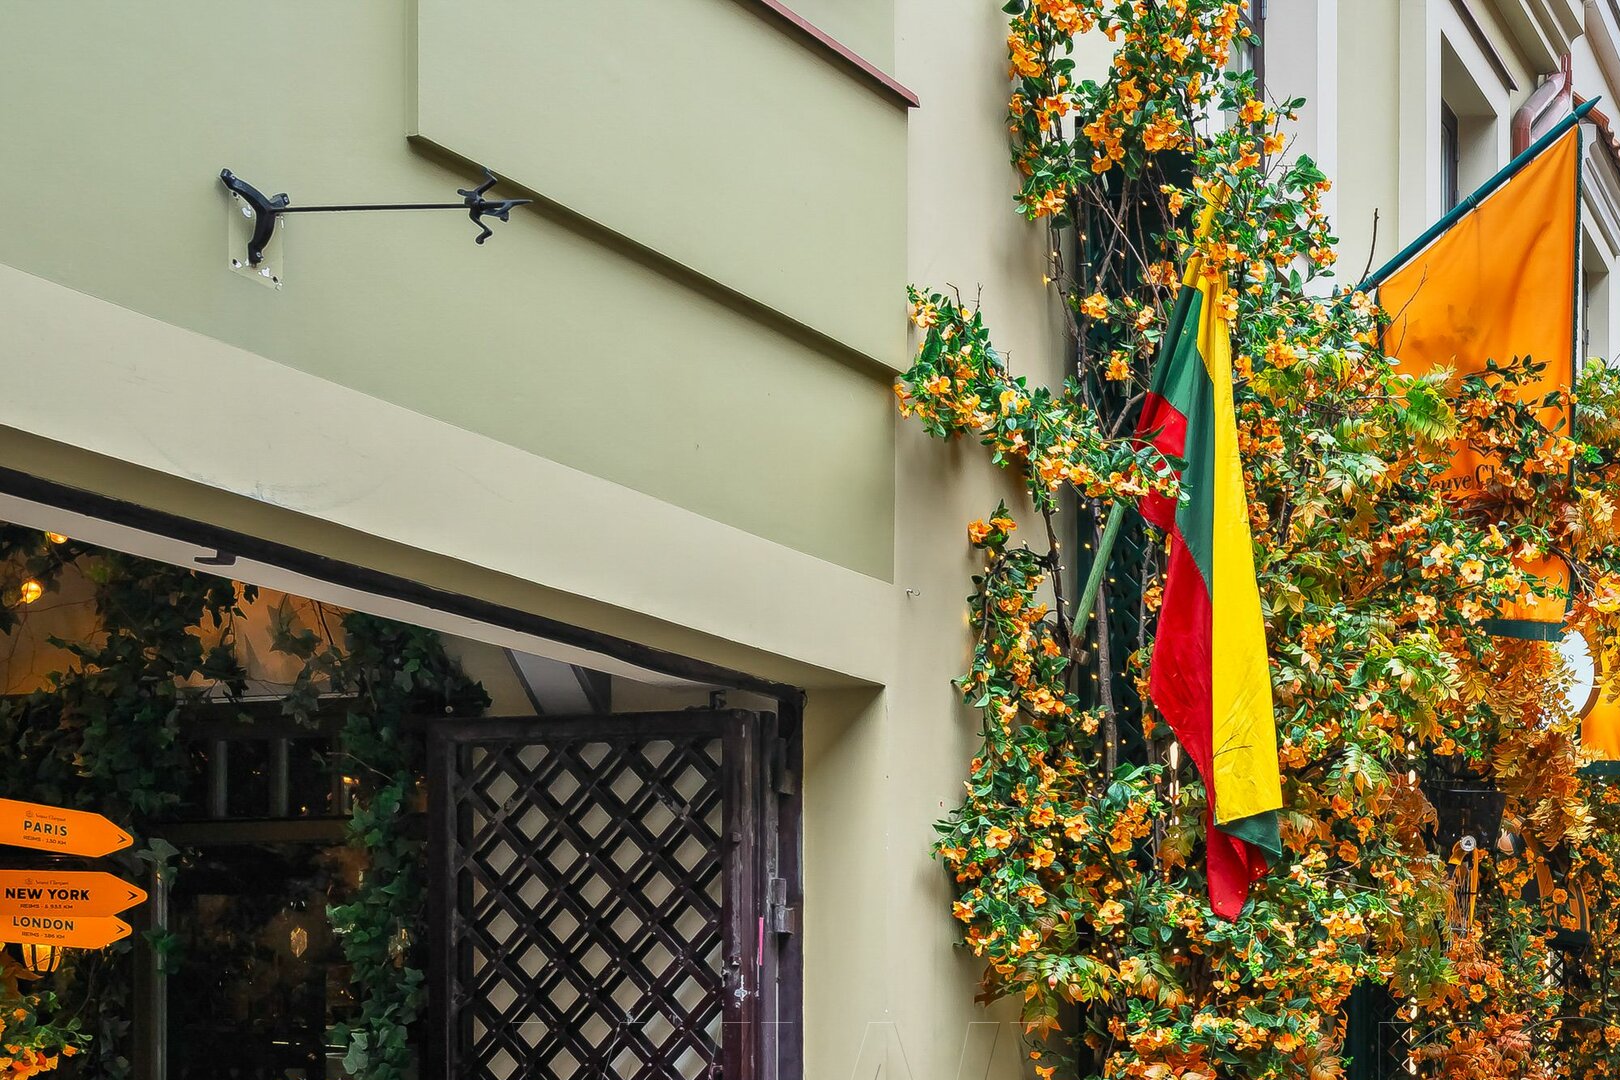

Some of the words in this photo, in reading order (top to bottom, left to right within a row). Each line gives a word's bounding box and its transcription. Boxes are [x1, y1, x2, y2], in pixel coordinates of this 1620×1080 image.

[1428, 475, 1472, 491] euve
[24, 820, 67, 836] PARIS
[5, 887, 43, 900] NEW
[47, 888, 90, 901] YORK
[13, 915, 74, 931] LONDON
